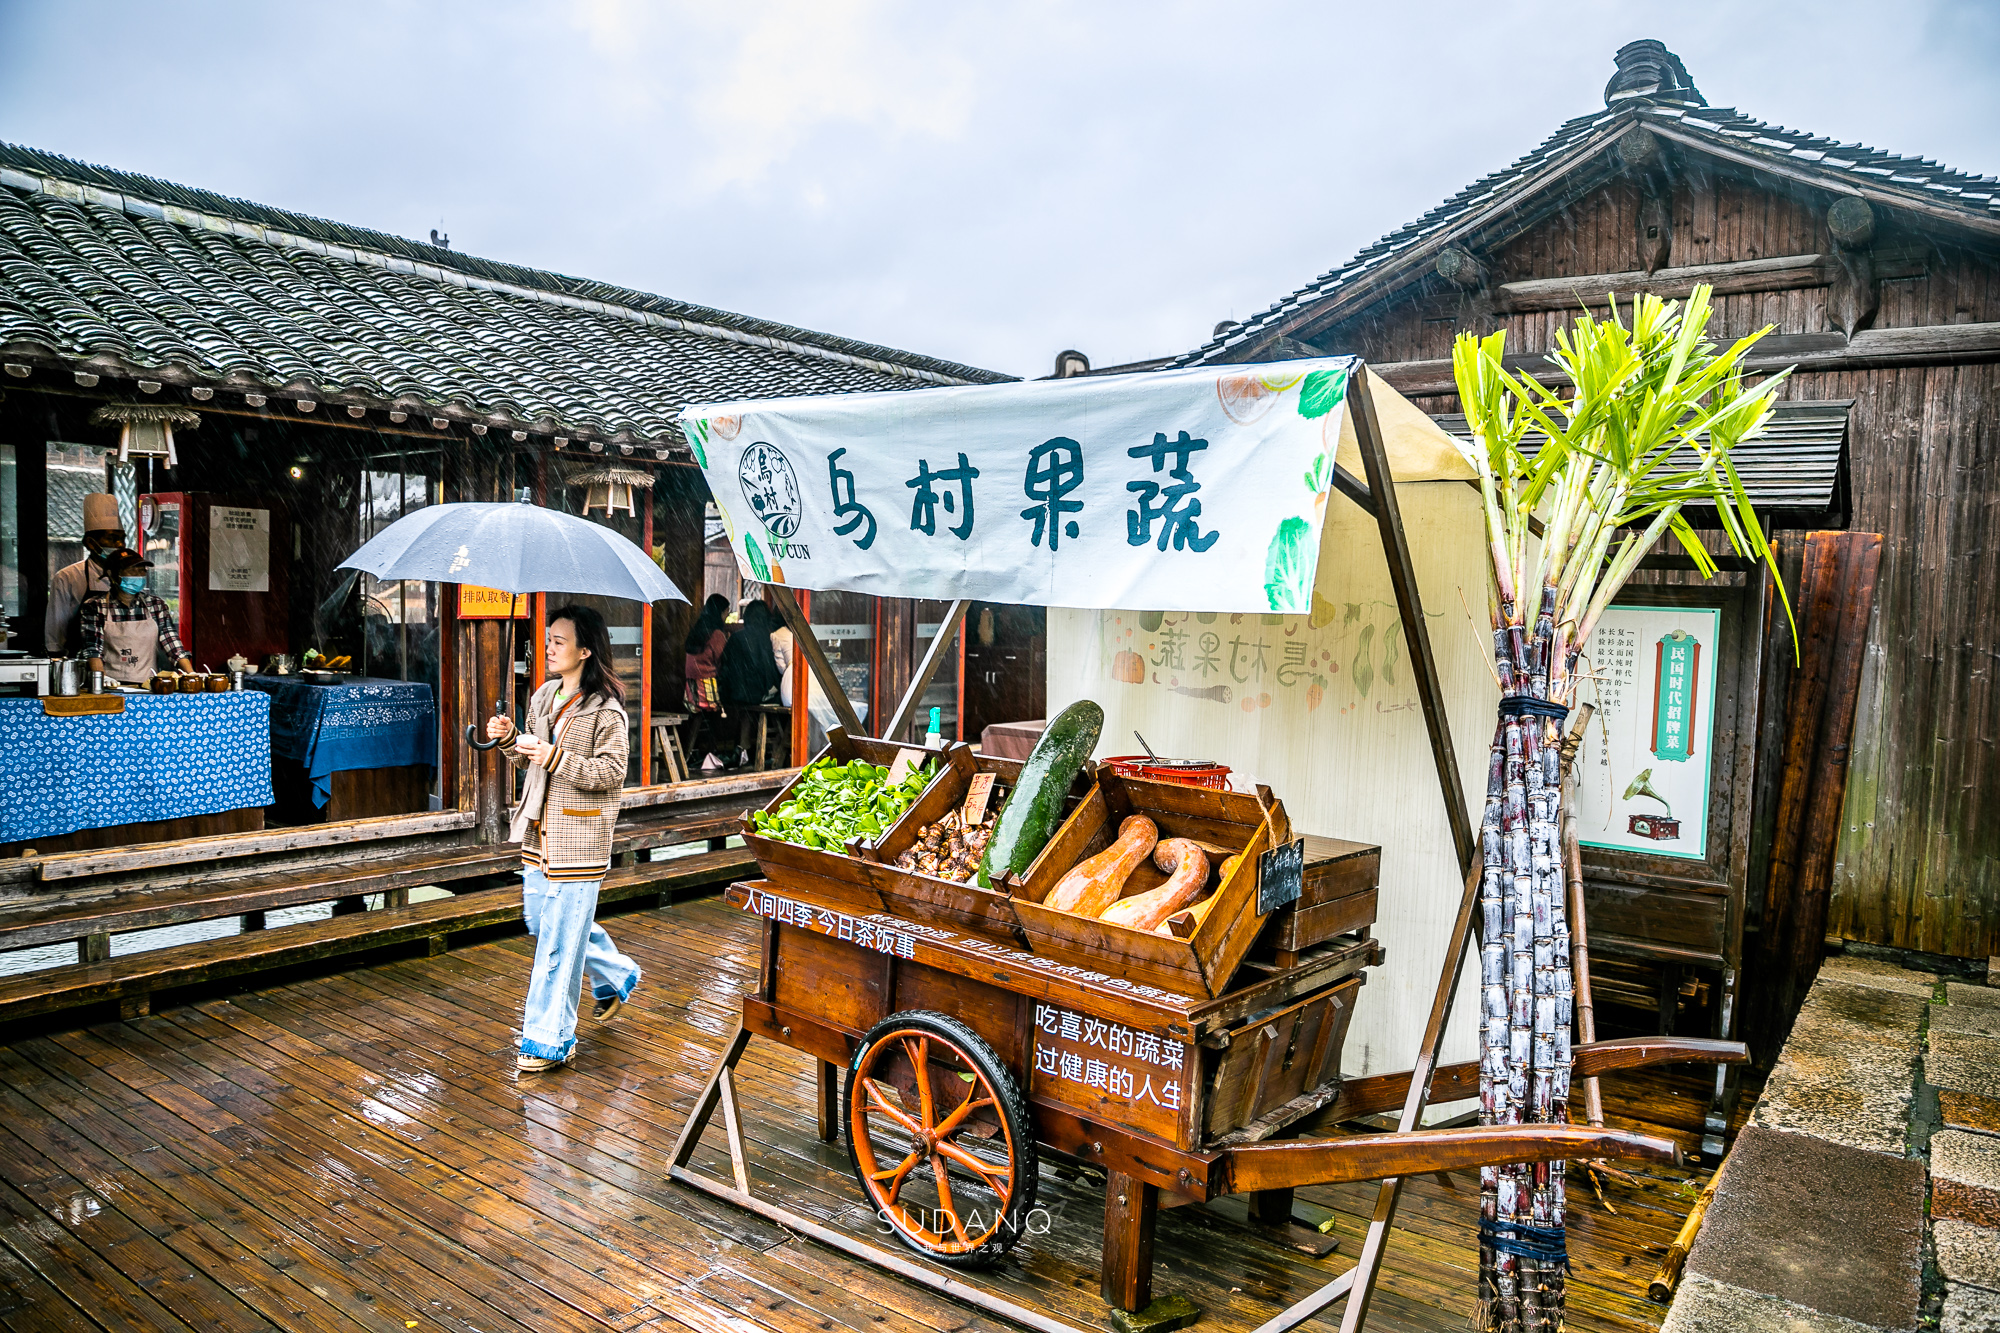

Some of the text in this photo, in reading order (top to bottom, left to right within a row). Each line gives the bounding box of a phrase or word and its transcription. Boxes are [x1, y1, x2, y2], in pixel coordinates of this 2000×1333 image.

[827, 430, 1220, 553] 乌村果蔬
[767, 542, 811, 560] WU CUN
[463, 590, 510, 604] 排队取餐
[1665, 646, 1685, 749] 民国时代招牌菜
[742, 889, 917, 960] 人间四季 今日茶饭事
[1035, 1004, 1184, 1071] 吃喜欢的蔬菜
[1035, 1042, 1181, 1111] 过健康的人生
